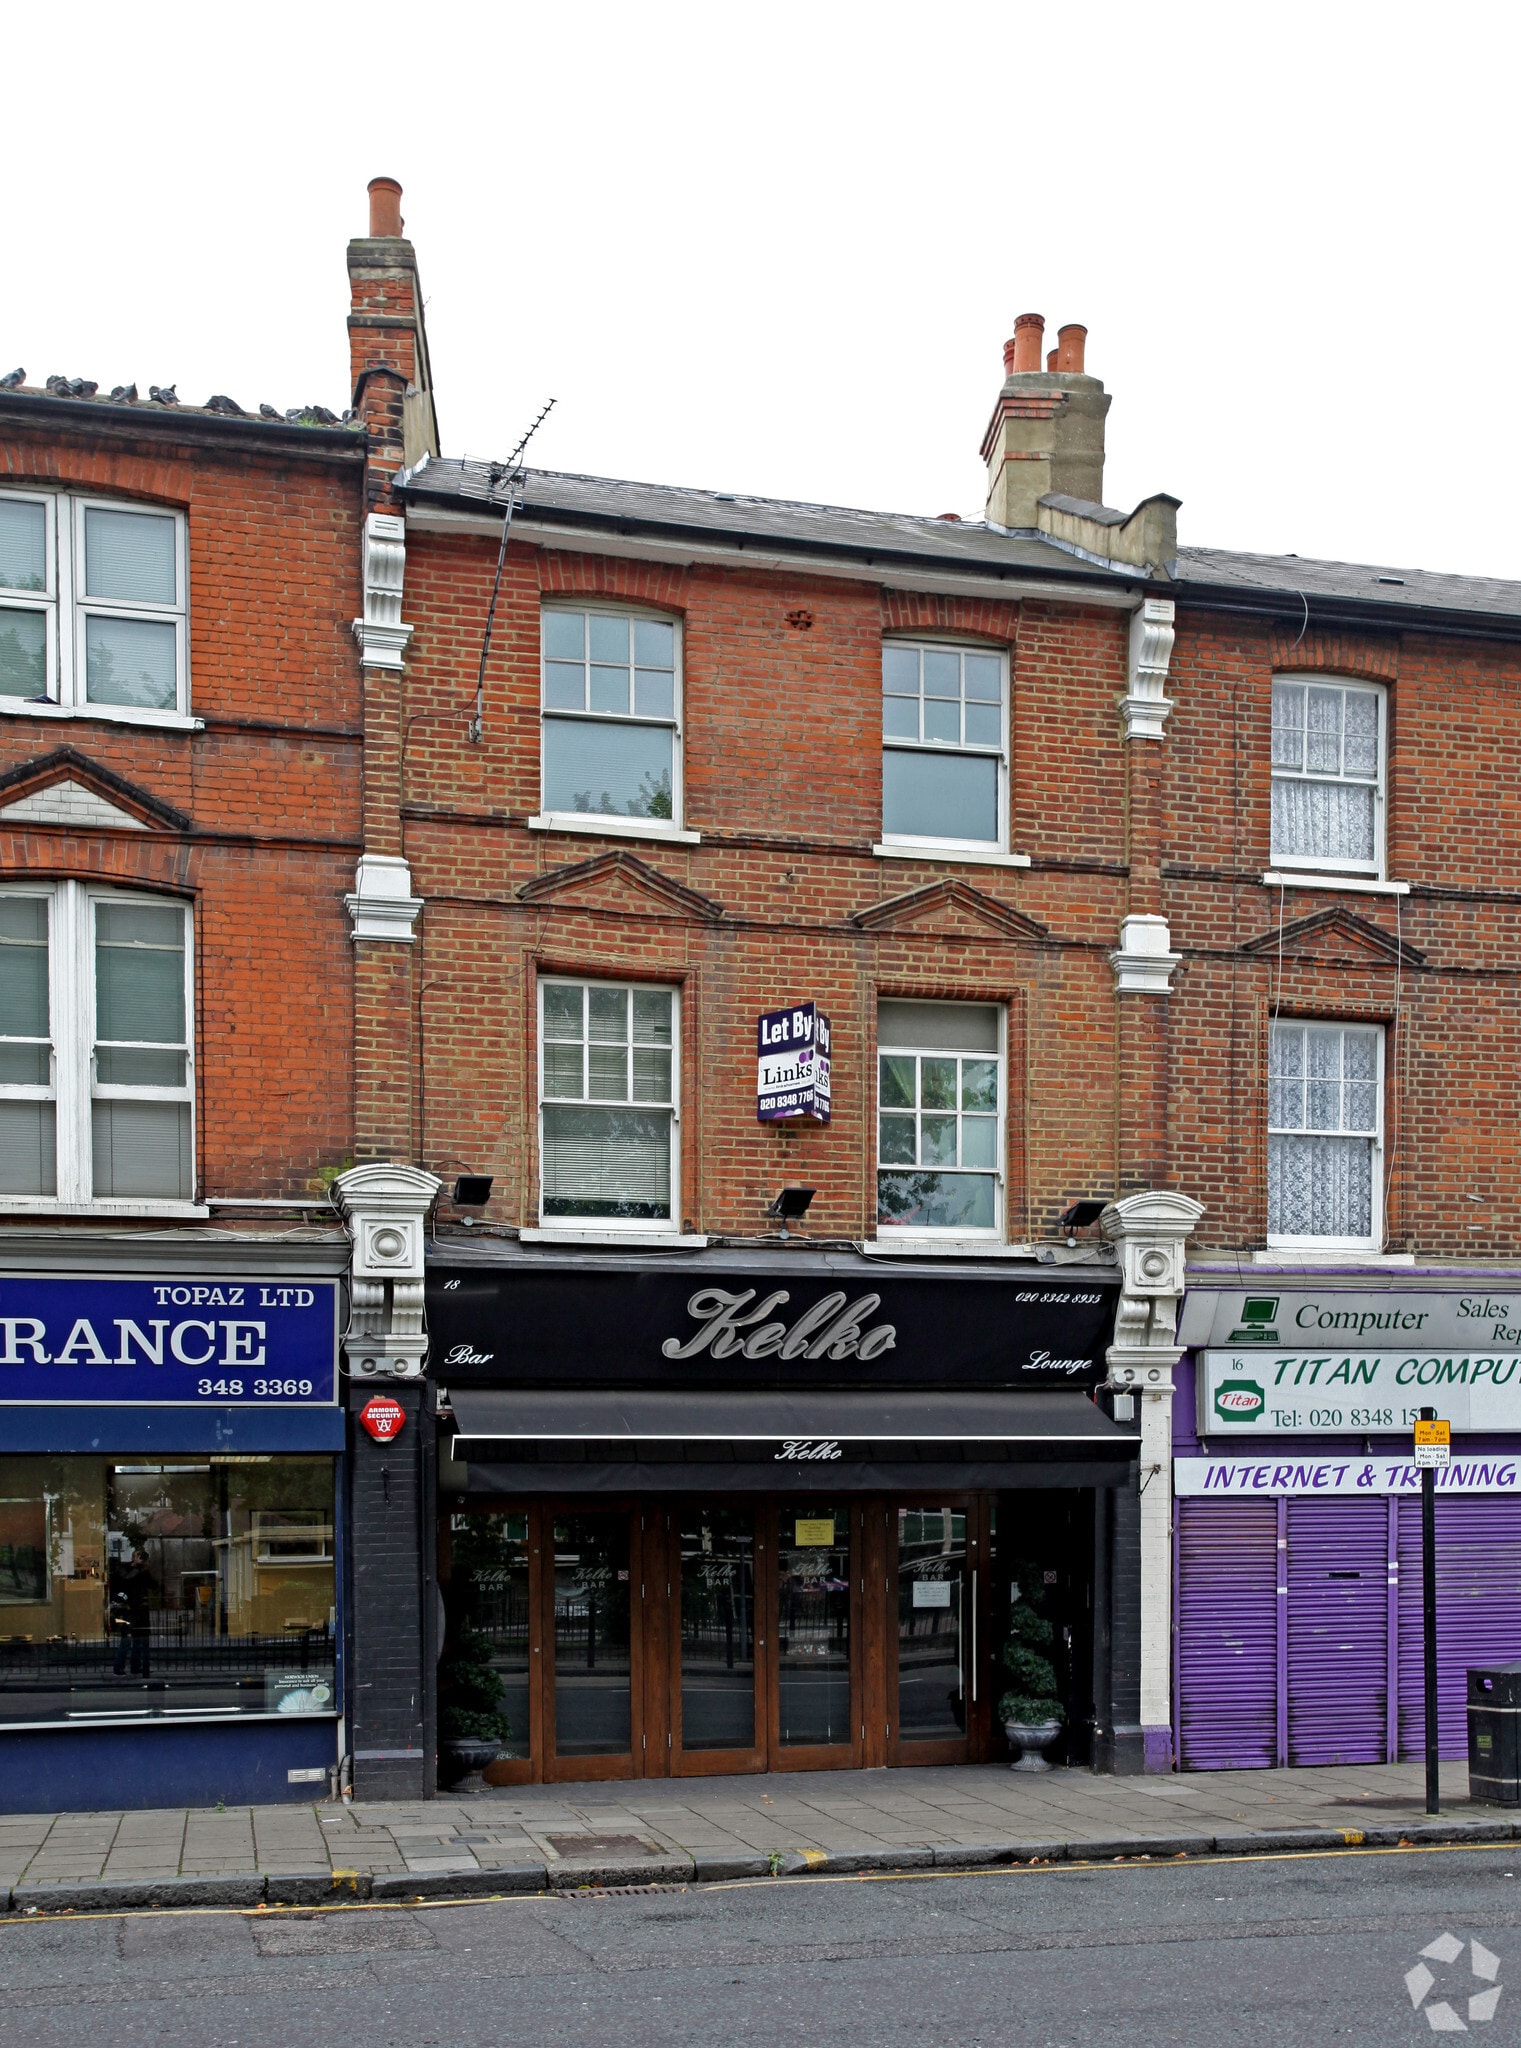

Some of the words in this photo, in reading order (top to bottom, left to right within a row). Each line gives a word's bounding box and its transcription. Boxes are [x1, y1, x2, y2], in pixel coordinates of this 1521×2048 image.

[762, 1018, 789, 1046] Let
[793, 1010, 812, 1042] By
[820, 1018, 830, 1053] By
[764, 1062, 812, 1086] Links
[760, 1097, 776, 1110] 020
[777, 1094, 798, 1108] 8348
[443, 1279, 461, 1290] 18
[154, 1286, 245, 1306] TOPAZ
[259, 1288, 315, 1308] LTD
[1014, 1292, 1038, 1303] 020
[1040, 1292, 1069, 1304] 8342
[1070, 1293, 1102, 1304] 8935
[1456, 1298, 1510, 1318] Sales
[661, 1288, 897, 1361] Kelko
[1295, 1304, 1429, 1336] Computer
[0, 1318, 266, 1366] RANCE
[444, 1344, 494, 1365] Bar
[1022, 1350, 1093, 1374] Lounge
[1232, 1358, 1244, 1371] 16
[1274, 1358, 1380, 1386] TITAN
[1396, 1358, 1521, 1386] COMPU
[198, 1379, 244, 1395] 348
[254, 1379, 313, 1396] 3369
[1222, 1394, 1259, 1406] Titan
[1271, 1410, 1301, 1428] Tel:
[1310, 1409, 1342, 1426] 020
[1350, 1408, 1393, 1426] 8348
[774, 1441, 842, 1460] Kelko
[1204, 1464, 1350, 1489] INTERNET
[1356, 1464, 1376, 1487] &
[469, 1570, 511, 1582] Kelko
[572, 1567, 612, 1581] Kelko
[697, 1564, 736, 1579] Kelko
[792, 1562, 833, 1576] Kelko
[913, 1560, 950, 1573] Kelko
